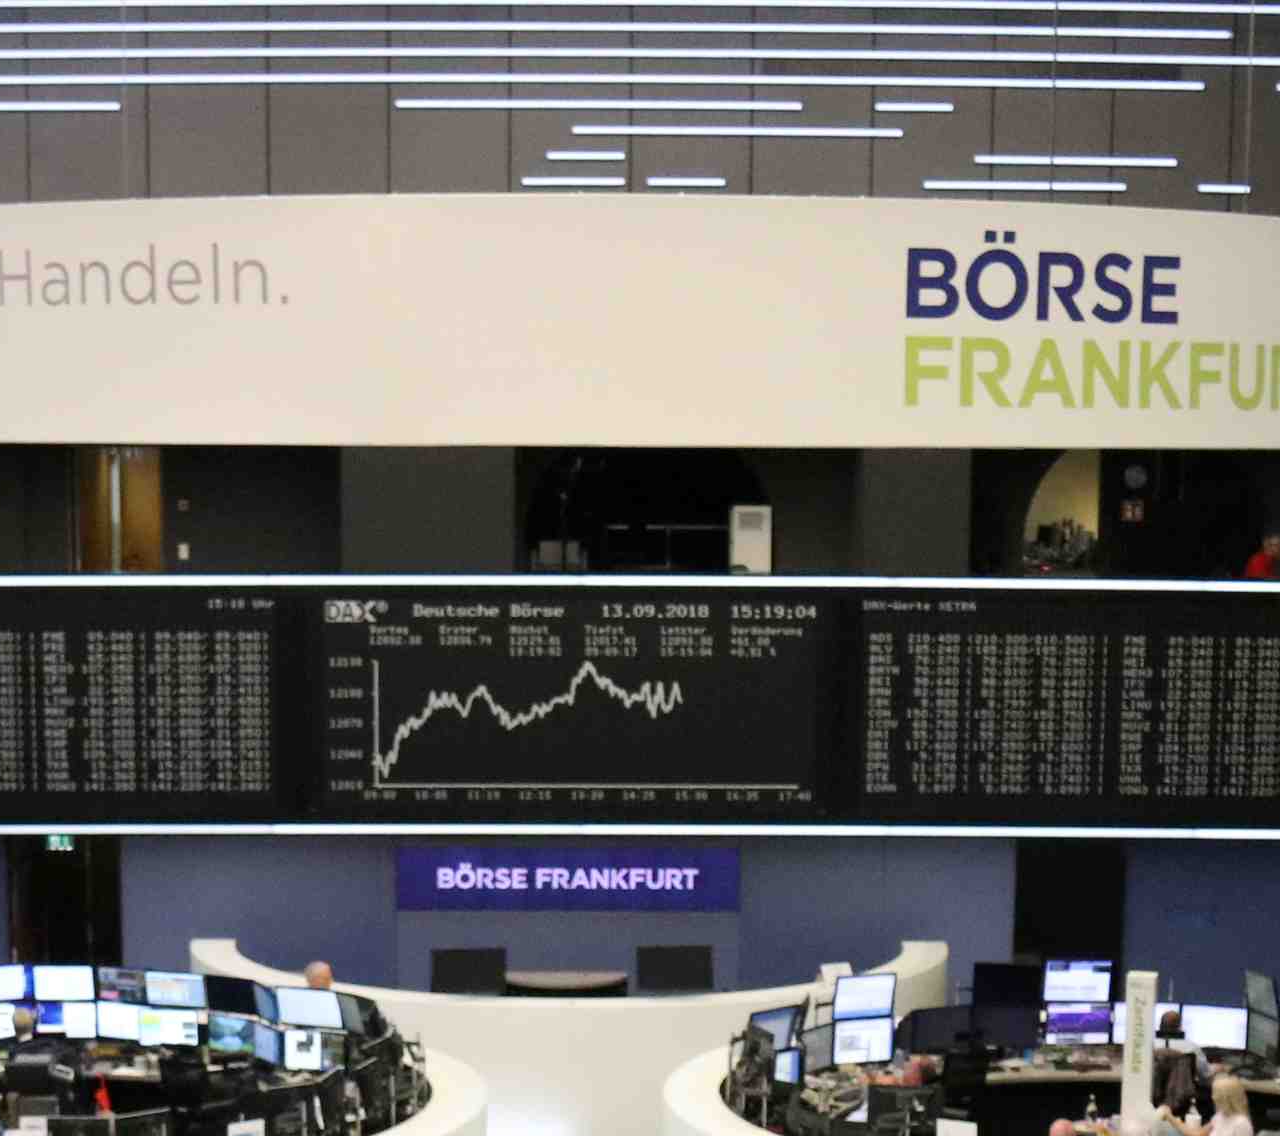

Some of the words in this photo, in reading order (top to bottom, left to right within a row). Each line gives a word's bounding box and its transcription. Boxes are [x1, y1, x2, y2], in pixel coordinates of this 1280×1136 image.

[906, 230, 1181, 324] BÖRSE
[412, 602, 500, 618] Deutsche
[509, 601, 565, 619] Börse
[601, 603, 710, 619] 13.09.2018
[730, 604, 817, 620] 15:19:04
[435, 862, 528, 890] BÖRSE
[535, 867, 700, 891] FRANKFURT
